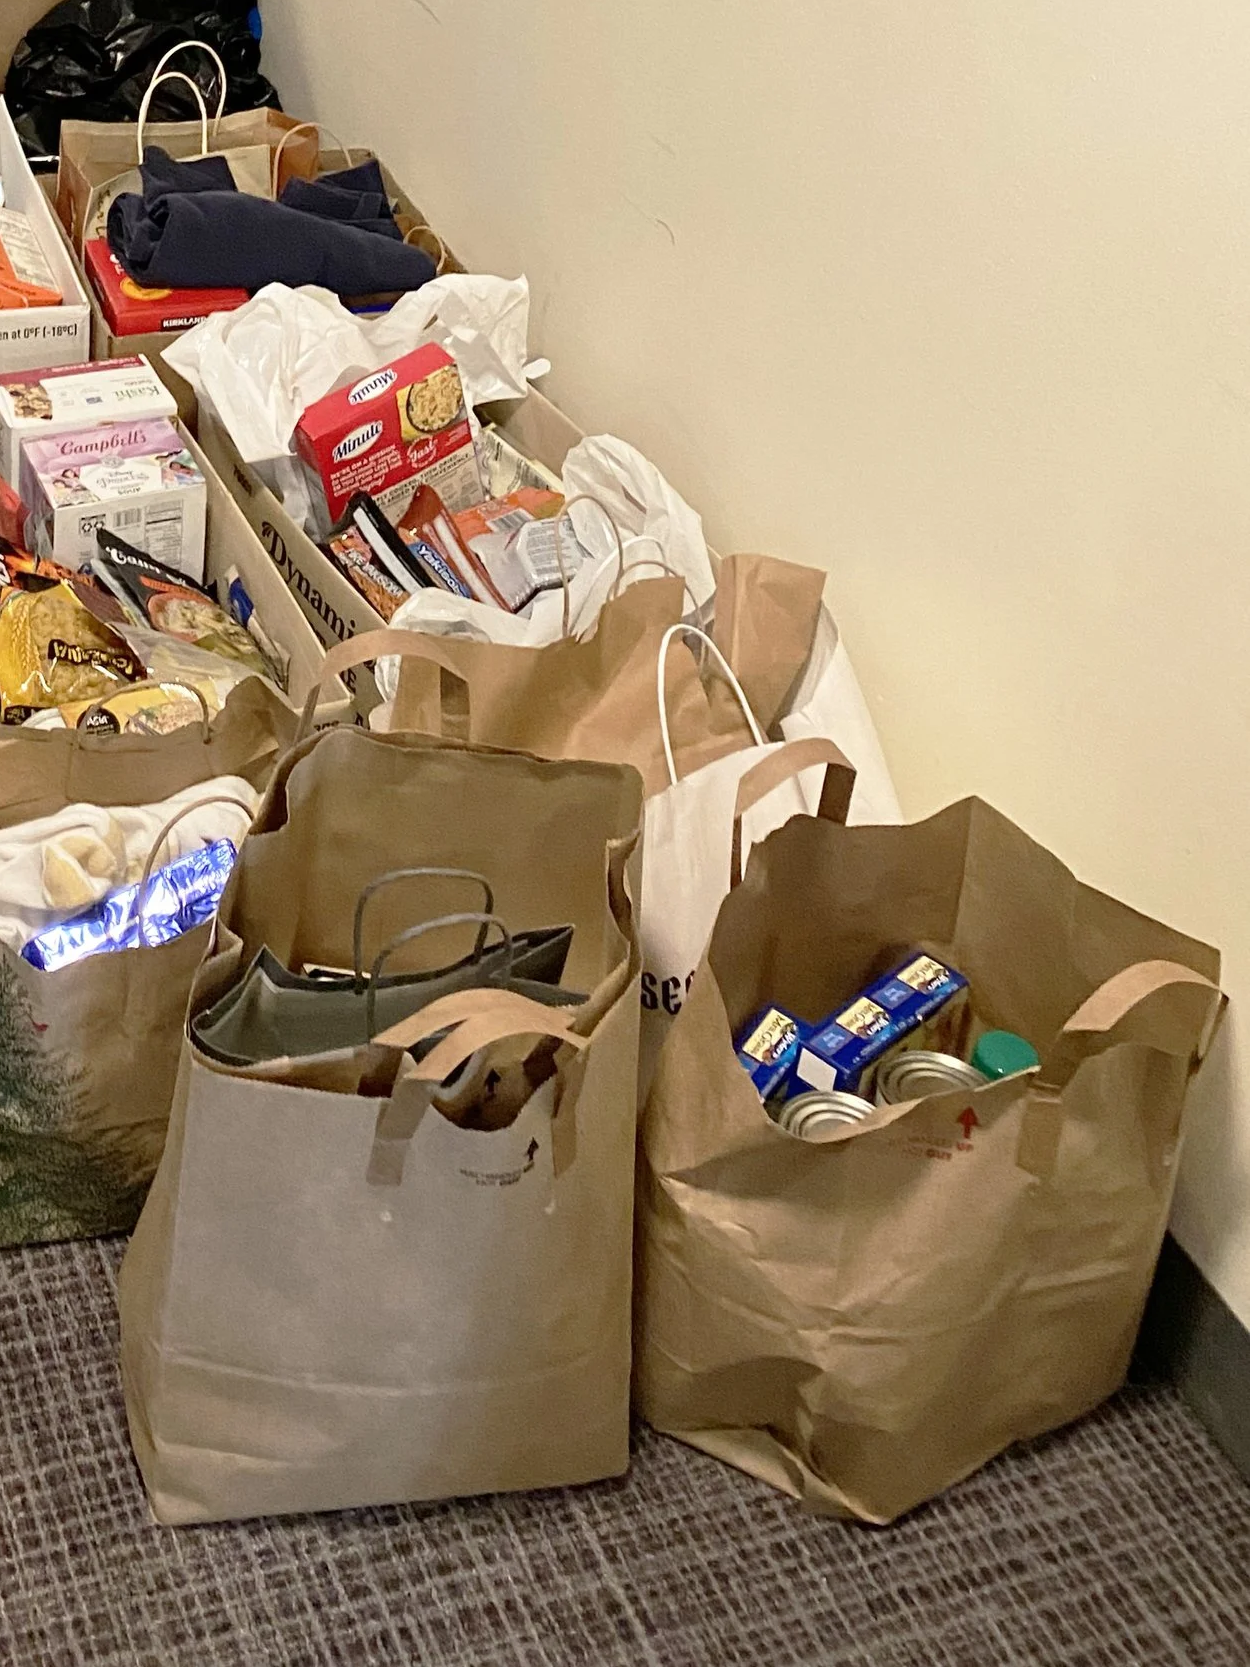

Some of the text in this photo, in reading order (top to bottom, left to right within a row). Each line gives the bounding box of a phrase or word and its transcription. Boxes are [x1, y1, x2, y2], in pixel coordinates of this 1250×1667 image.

[11, 329, 21, 339] at
[114, 386, 160, 401] Kashi
[350, 371, 395, 404] Minute
[60, 429, 147, 456] Campbell's
[333, 421, 383, 461] Minute
[261, 520, 357, 641] Dynami
[417, 544, 461, 596] Yakisob
